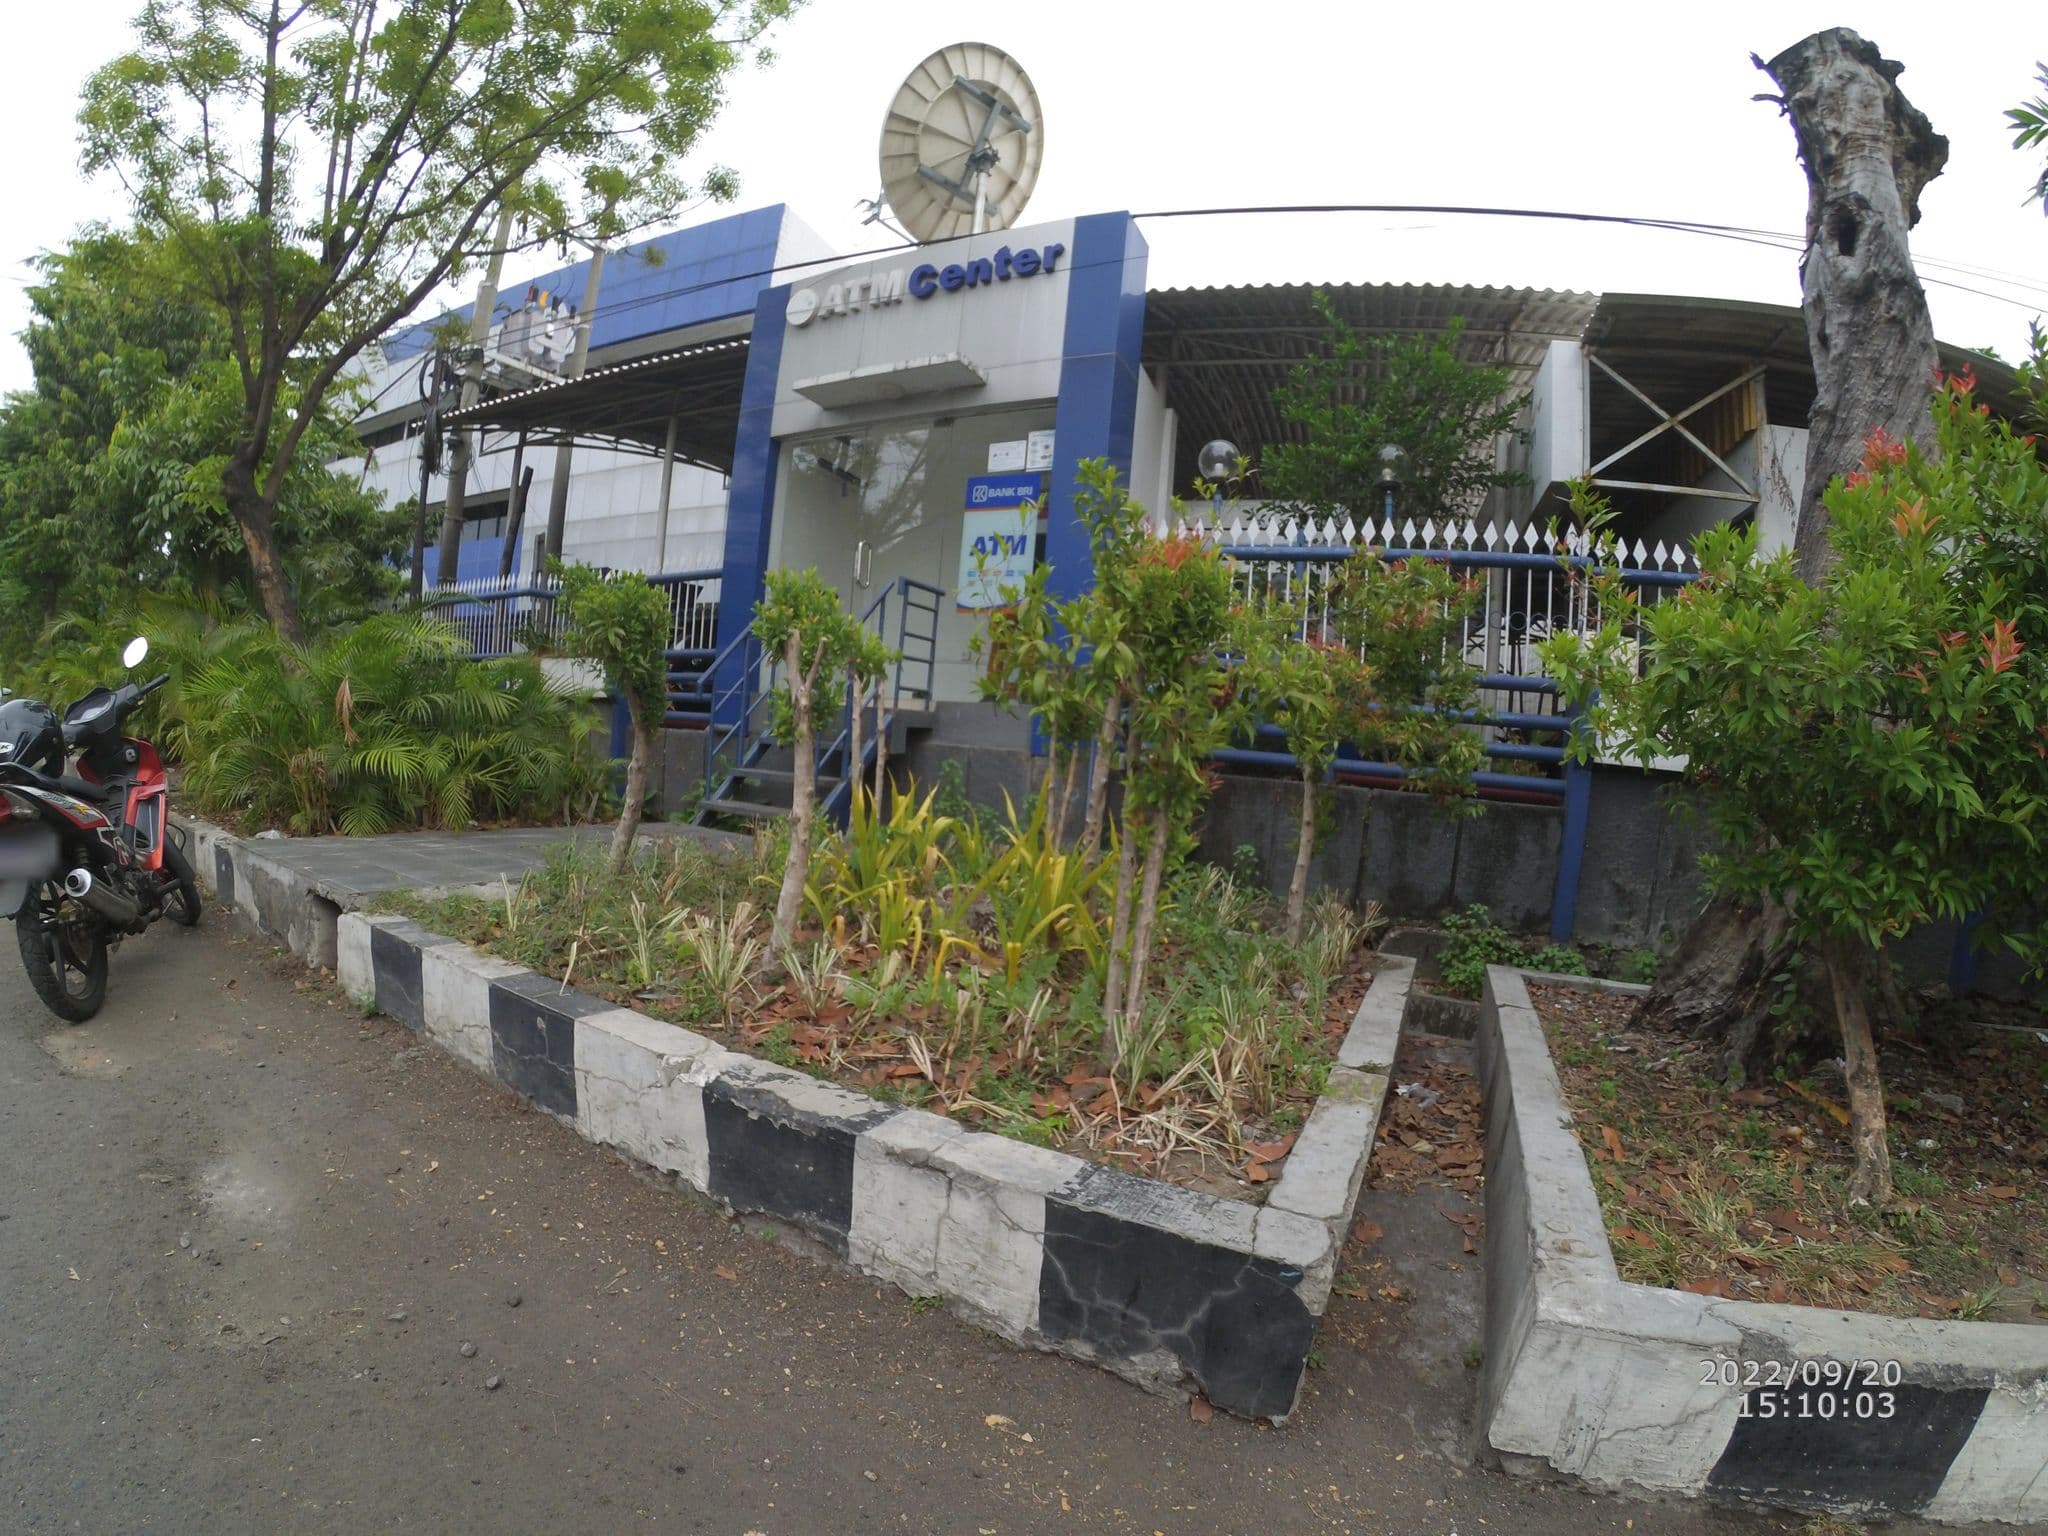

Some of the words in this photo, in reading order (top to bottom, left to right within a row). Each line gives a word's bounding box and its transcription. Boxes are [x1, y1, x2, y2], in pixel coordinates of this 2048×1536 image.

[817, 268, 907, 318] ATM
[908, 243, 1064, 299] Center
[988, 488, 1014, 497] BANK
[1016, 486, 1033, 496] BRI
[969, 534, 1028, 557] ATM
